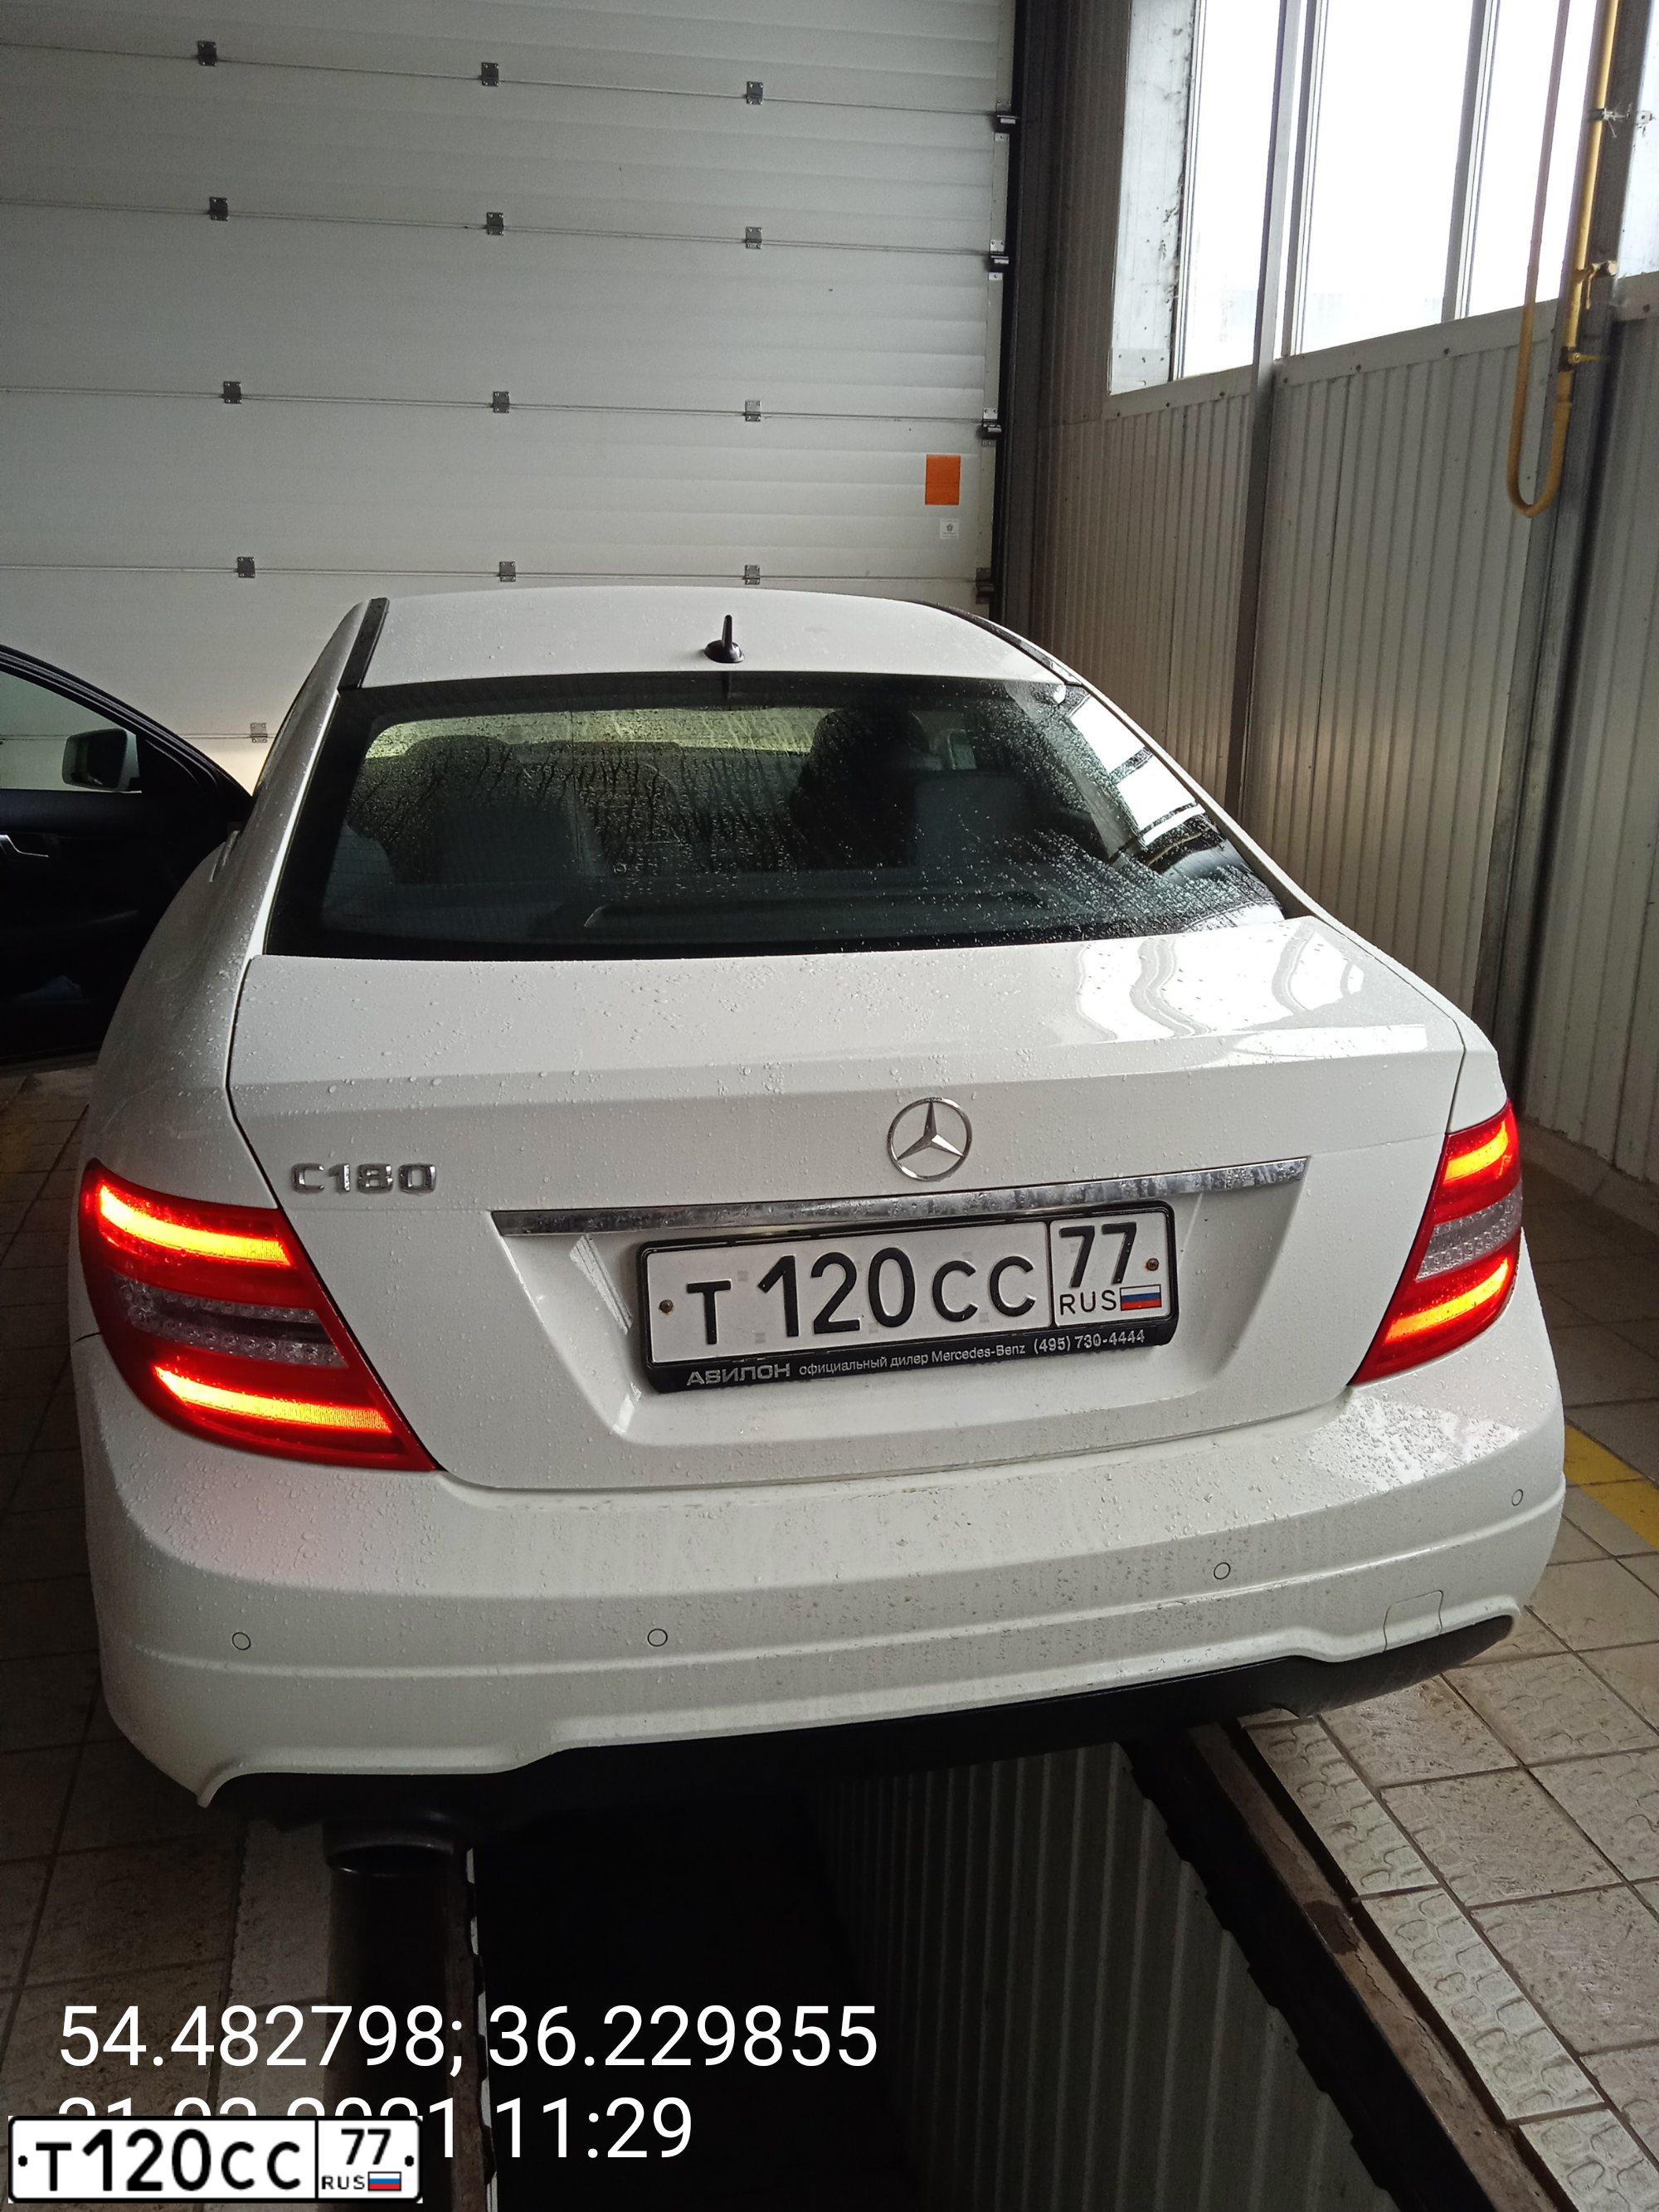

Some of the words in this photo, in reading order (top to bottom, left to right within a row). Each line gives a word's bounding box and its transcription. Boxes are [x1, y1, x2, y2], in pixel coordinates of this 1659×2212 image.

[291, 1163, 436, 1194] C180
[1059, 1222, 1136, 1289] 77
[1059, 1289, 1117, 1315] RUS
[686, 1362, 791, 1386] АВИЛОН
[799, 1355, 888, 1376] официальный
[890, 1352, 929, 1368] дилер
[931, 1344, 1026, 1363] Mercedes-Benz
[1033, 1334, 1072, 1355] (495)
[1074, 1328, 1146, 1350] 730-4444
